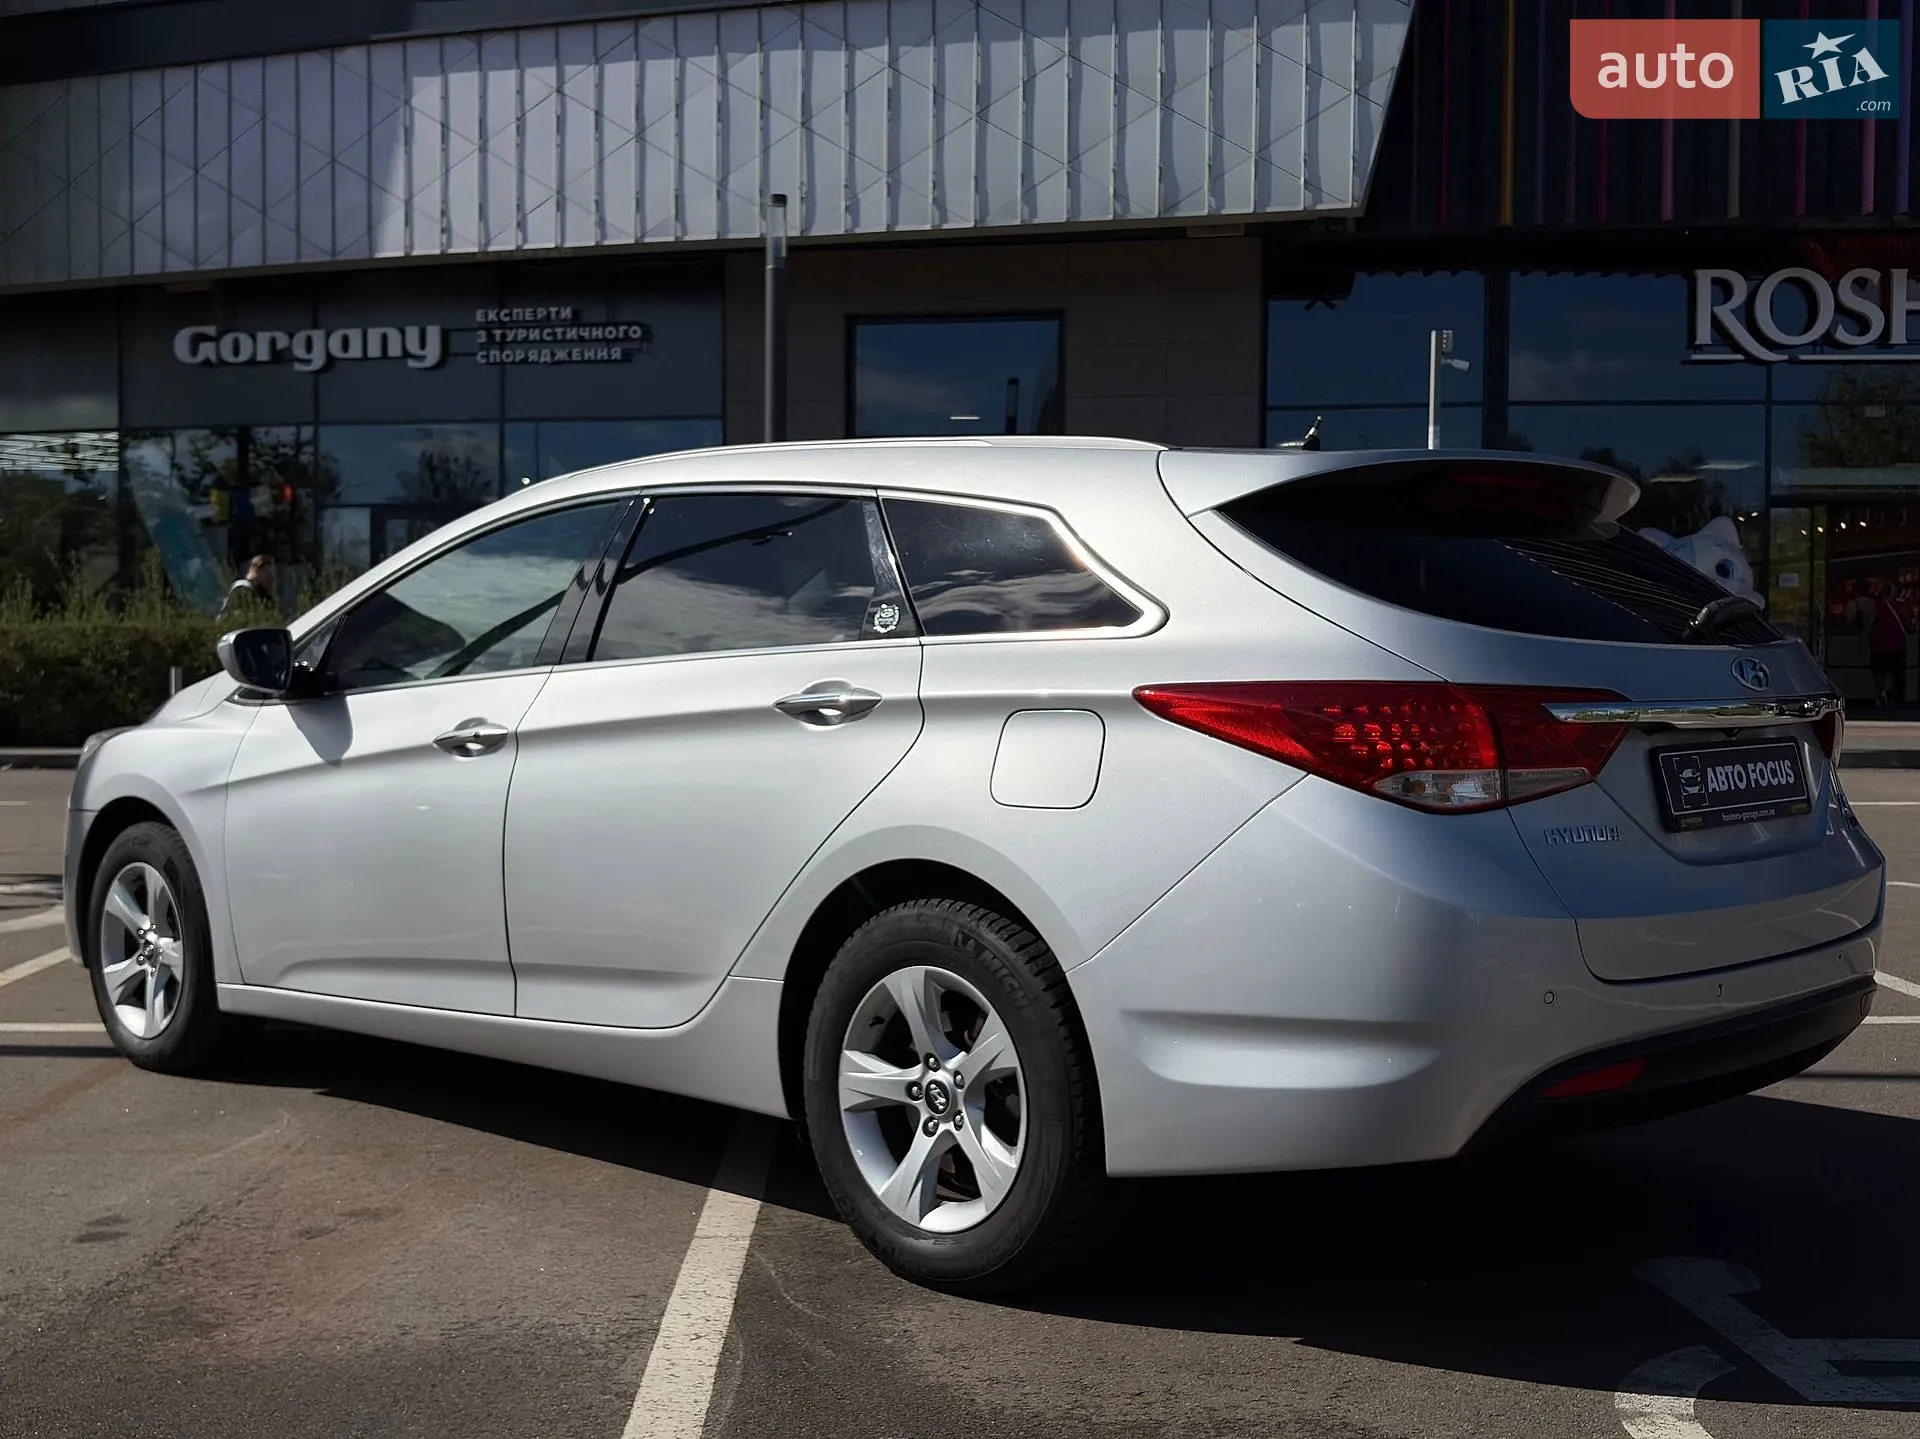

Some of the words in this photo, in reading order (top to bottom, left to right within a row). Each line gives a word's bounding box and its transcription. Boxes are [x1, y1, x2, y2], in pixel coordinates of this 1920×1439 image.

[475, 306, 573, 323] ЕКСПЕРТИ
[492, 324, 643, 343] ТУРИСТИЧНОГО
[173, 324, 442, 372] Gorgany
[476, 347, 623, 364] СПОРЯДЖЕННЯ
[1749, 759, 1795, 788] FOCUS
